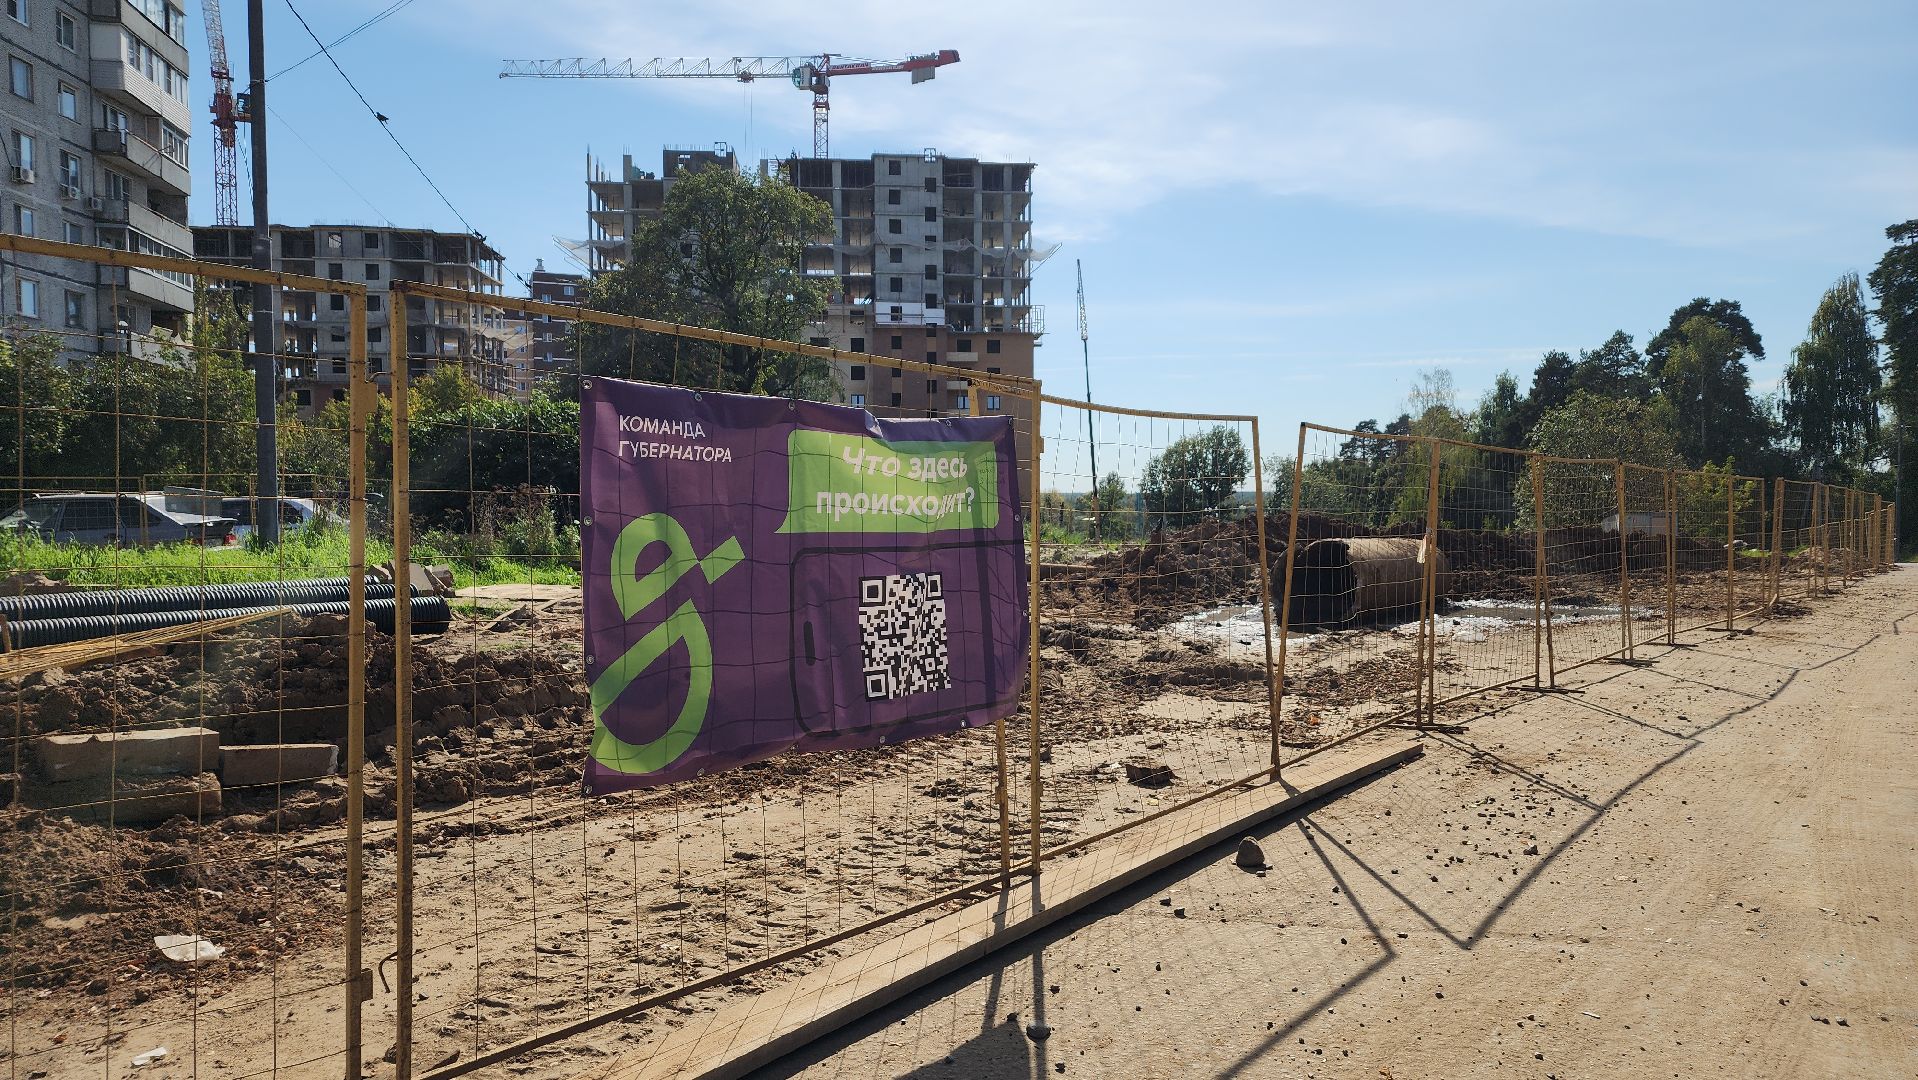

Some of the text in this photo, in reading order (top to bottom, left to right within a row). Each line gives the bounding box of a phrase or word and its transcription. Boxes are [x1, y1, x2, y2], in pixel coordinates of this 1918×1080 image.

[619, 414, 706, 440] КОМАНДА
[618, 440, 732, 463] ГУБЕРНАТОРА
[842, 446, 968, 482] Что здесь
[816, 486, 975, 522] происходит?
